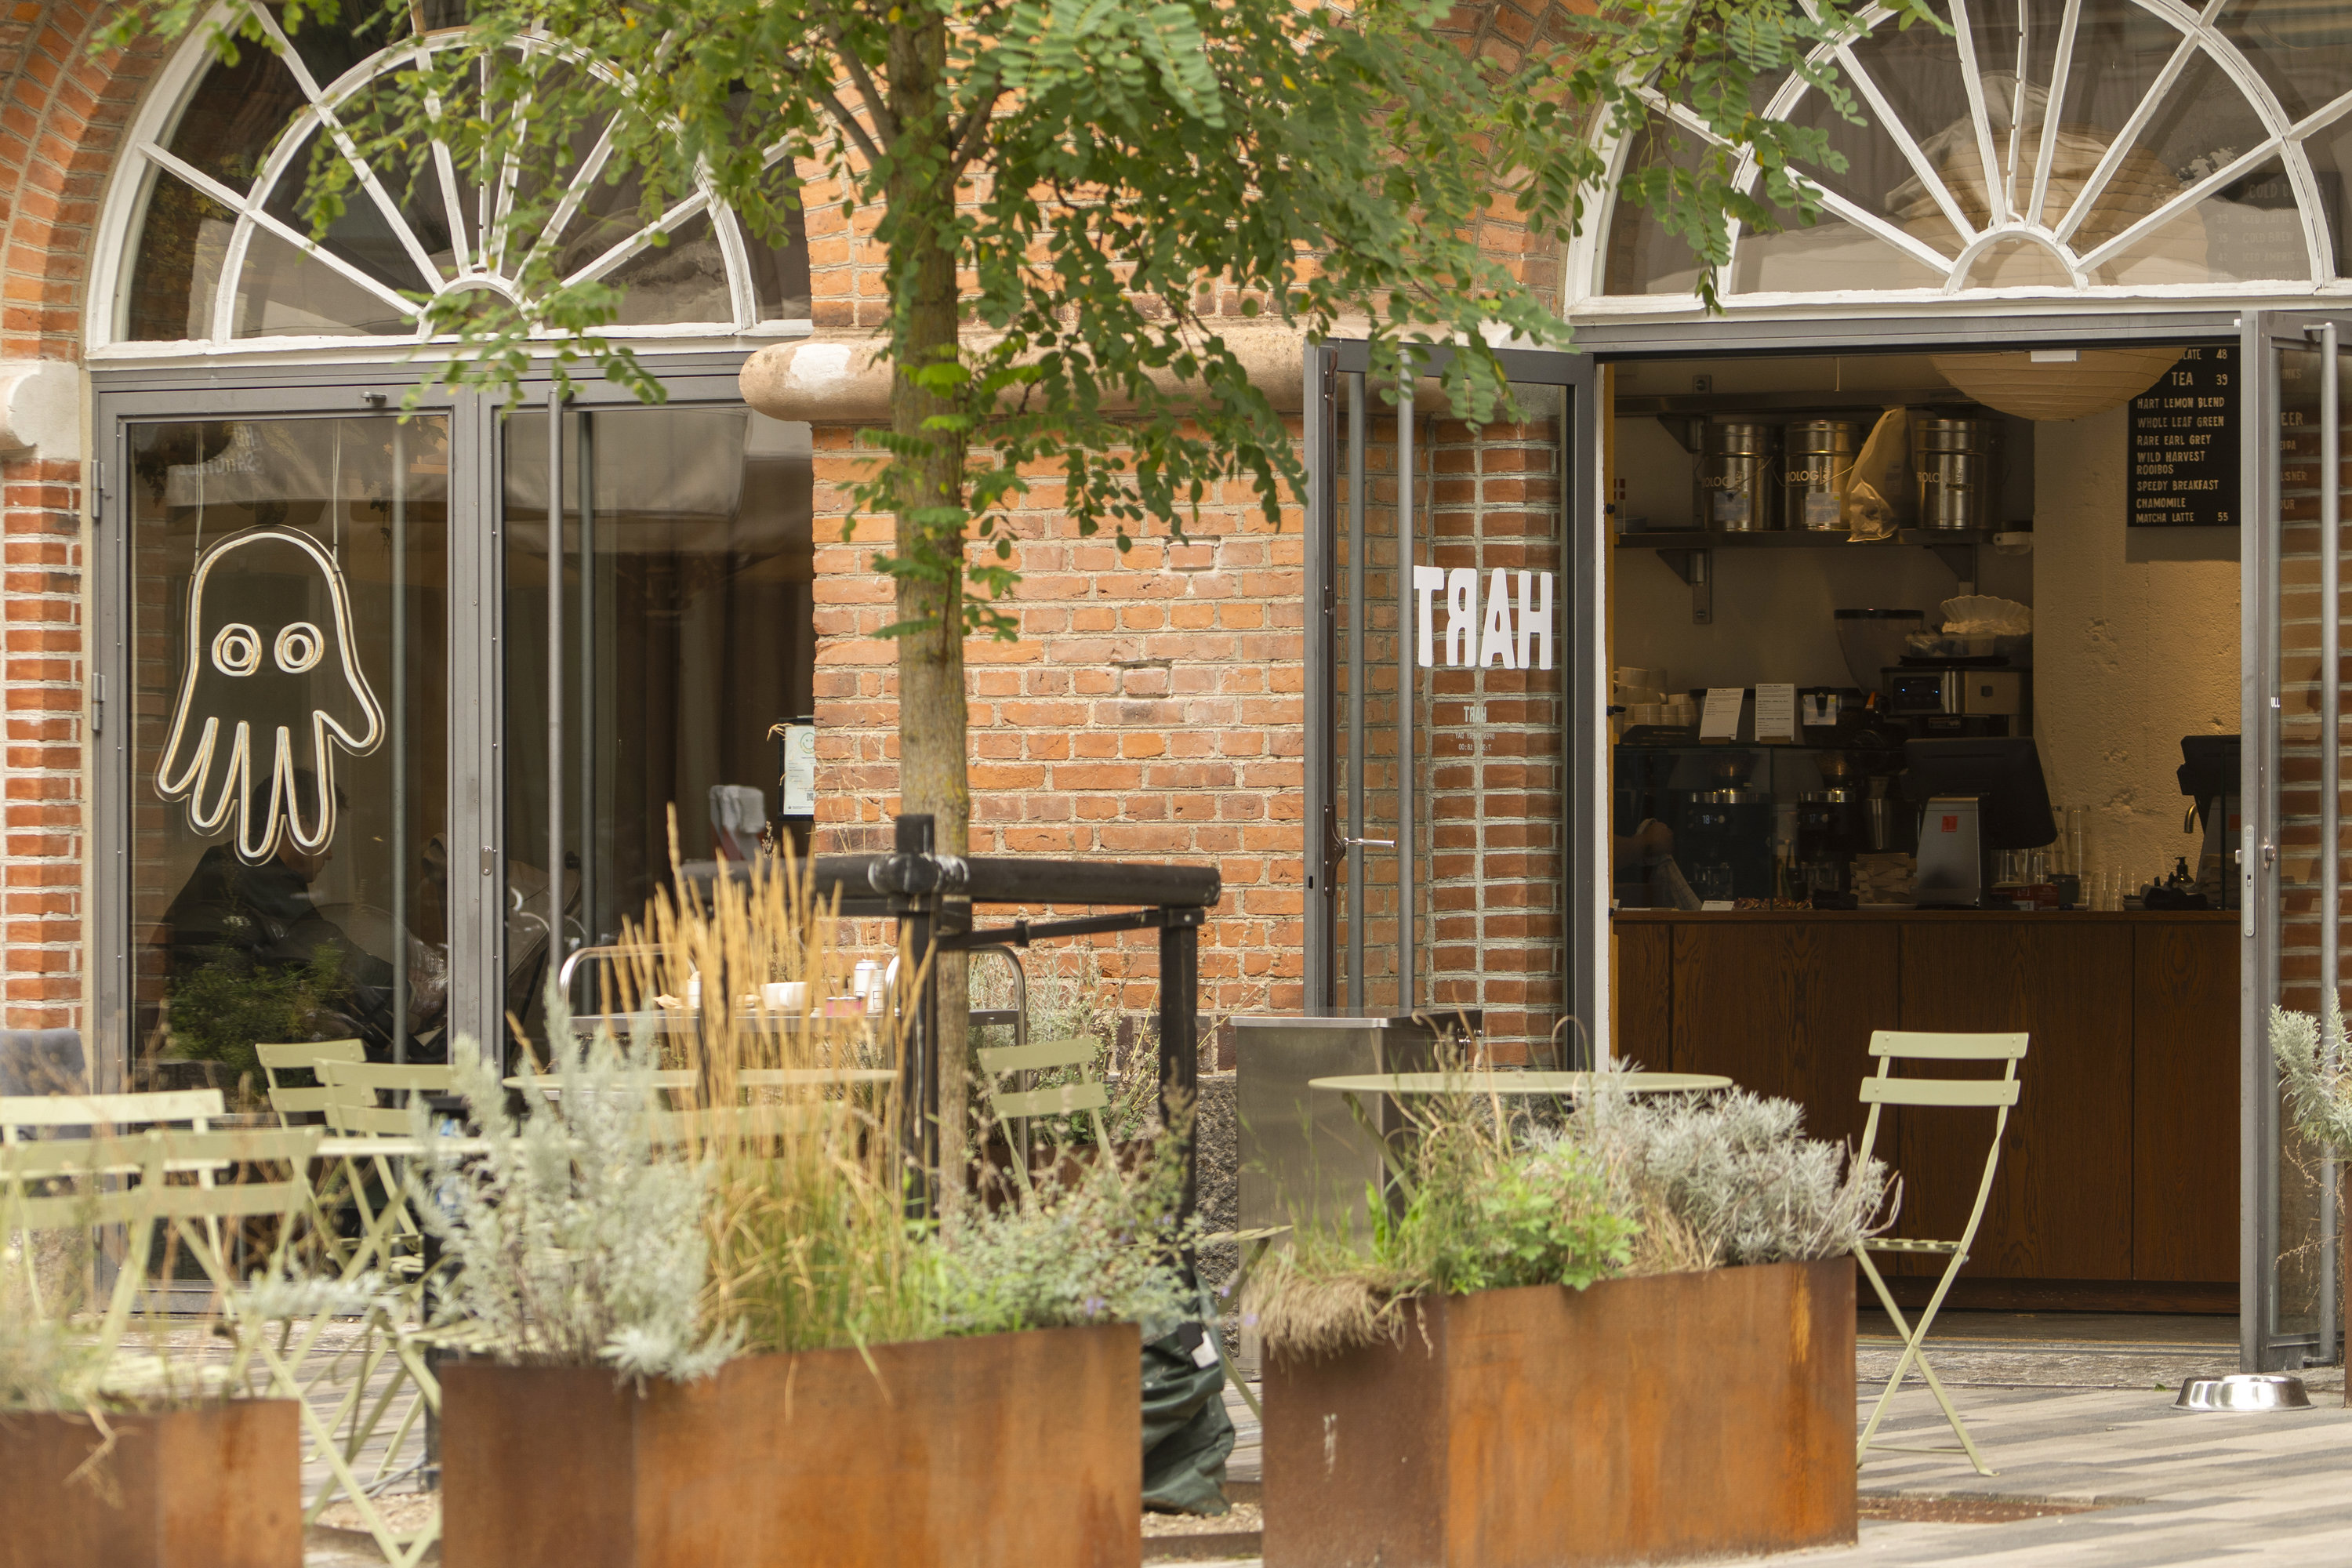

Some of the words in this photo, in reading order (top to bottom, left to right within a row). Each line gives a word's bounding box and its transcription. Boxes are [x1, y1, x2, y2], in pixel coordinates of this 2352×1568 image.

[2182, 349, 2201, 360] LATE
[2216, 349, 2227, 360] 48
[2171, 372, 2194, 386] TEA
[2216, 374, 2228, 386] 39
[2137, 398, 2159, 409] HART
[2164, 397, 2194, 408] LEMON
[2198, 397, 2224, 408] BLEND
[2137, 417, 2168, 428] WHOLE
[2172, 416, 2193, 427] LEAF
[2197, 416, 2224, 427] GREEN
[2280, 412, 2303, 426] EER
[2137, 435, 2159, 445] RARE
[2164, 435, 2185, 445] EARL
[2189, 434, 2212, 445] GREY
[2137, 452, 2161, 463] WILD
[2165, 451, 2205, 462] HARVEST
[2136, 464, 2174, 475] ROOIBOS
[2136, 481, 2168, 492] SPEEDY
[2172, 480, 2219, 491] BREAKFAST
[2136, 498, 2186, 509] CHAMOMILE
[2136, 514, 2167, 523] MATCHA
[2172, 512, 2194, 522] LATTE
[2217, 512, 2229, 522] 55
[2270, 697, 2281, 708] ULL
